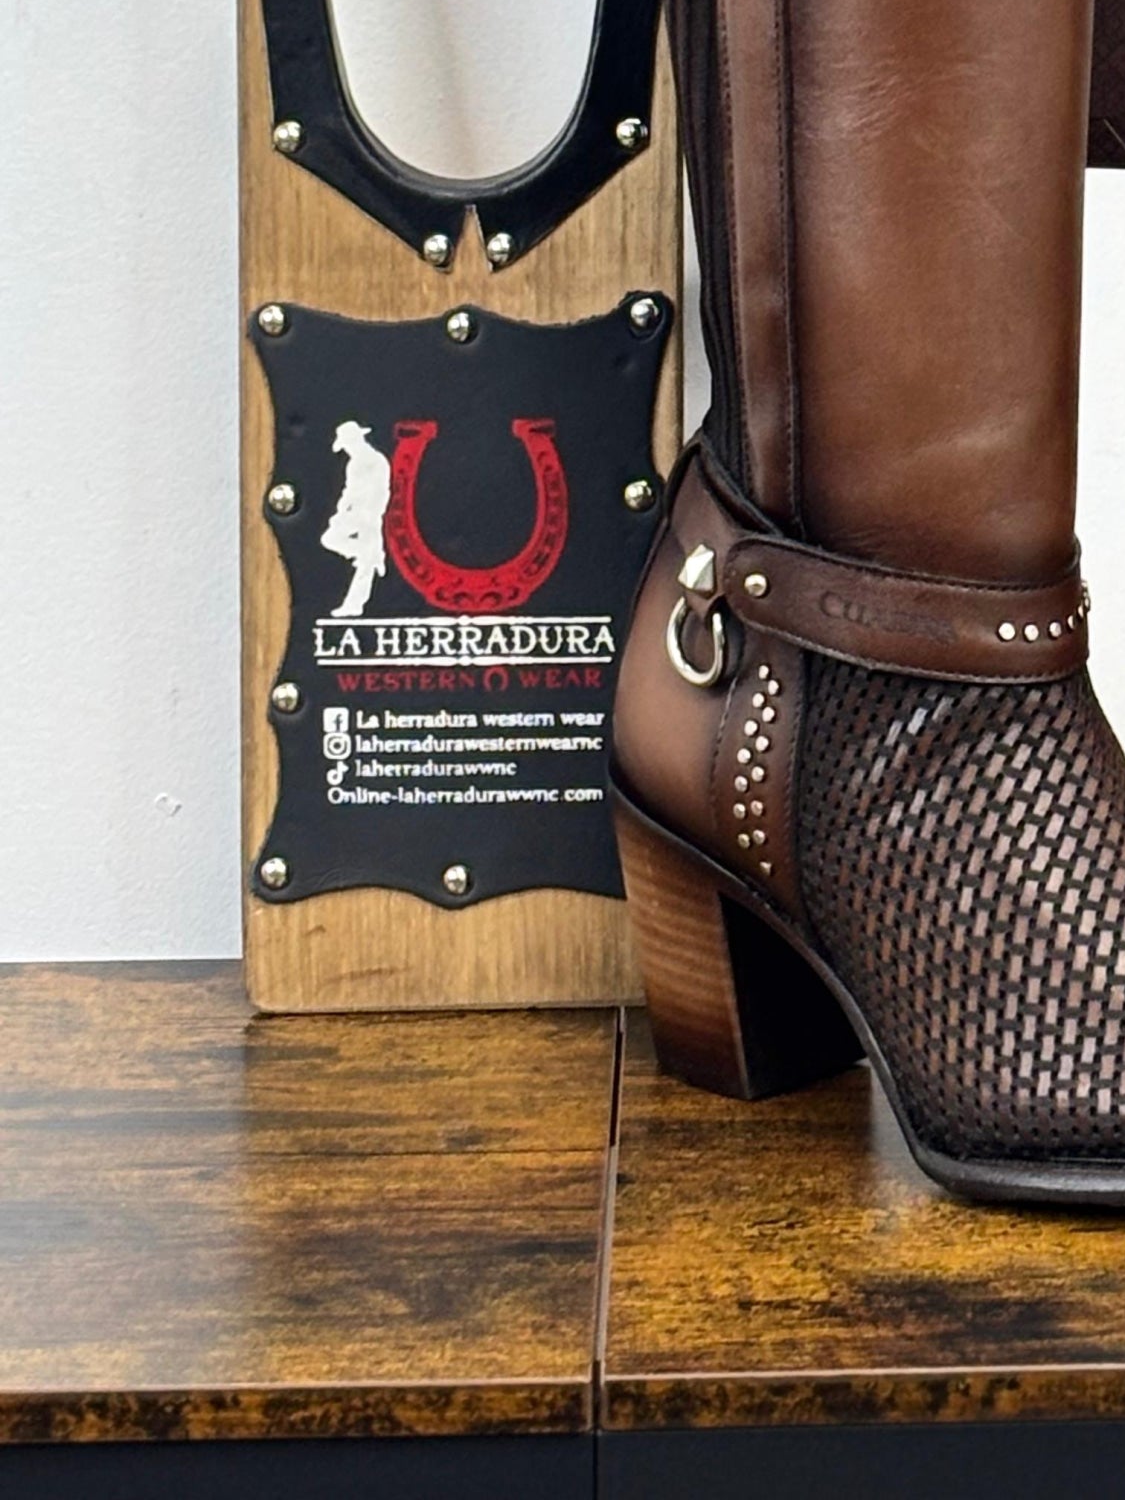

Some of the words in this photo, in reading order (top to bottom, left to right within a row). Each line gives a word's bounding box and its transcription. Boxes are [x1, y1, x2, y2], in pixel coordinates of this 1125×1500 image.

[313, 628, 361, 657] LA
[375, 625, 616, 655] HERRADURA
[336, 670, 475, 692] WESTERN
[519, 668, 602, 689] WEAR
[356, 711, 379, 729] La
[385, 710, 477, 729] herradura
[482, 712, 554, 728] western
[561, 712, 604, 726] wear
[355, 760, 517, 778] laherradurawwnc
